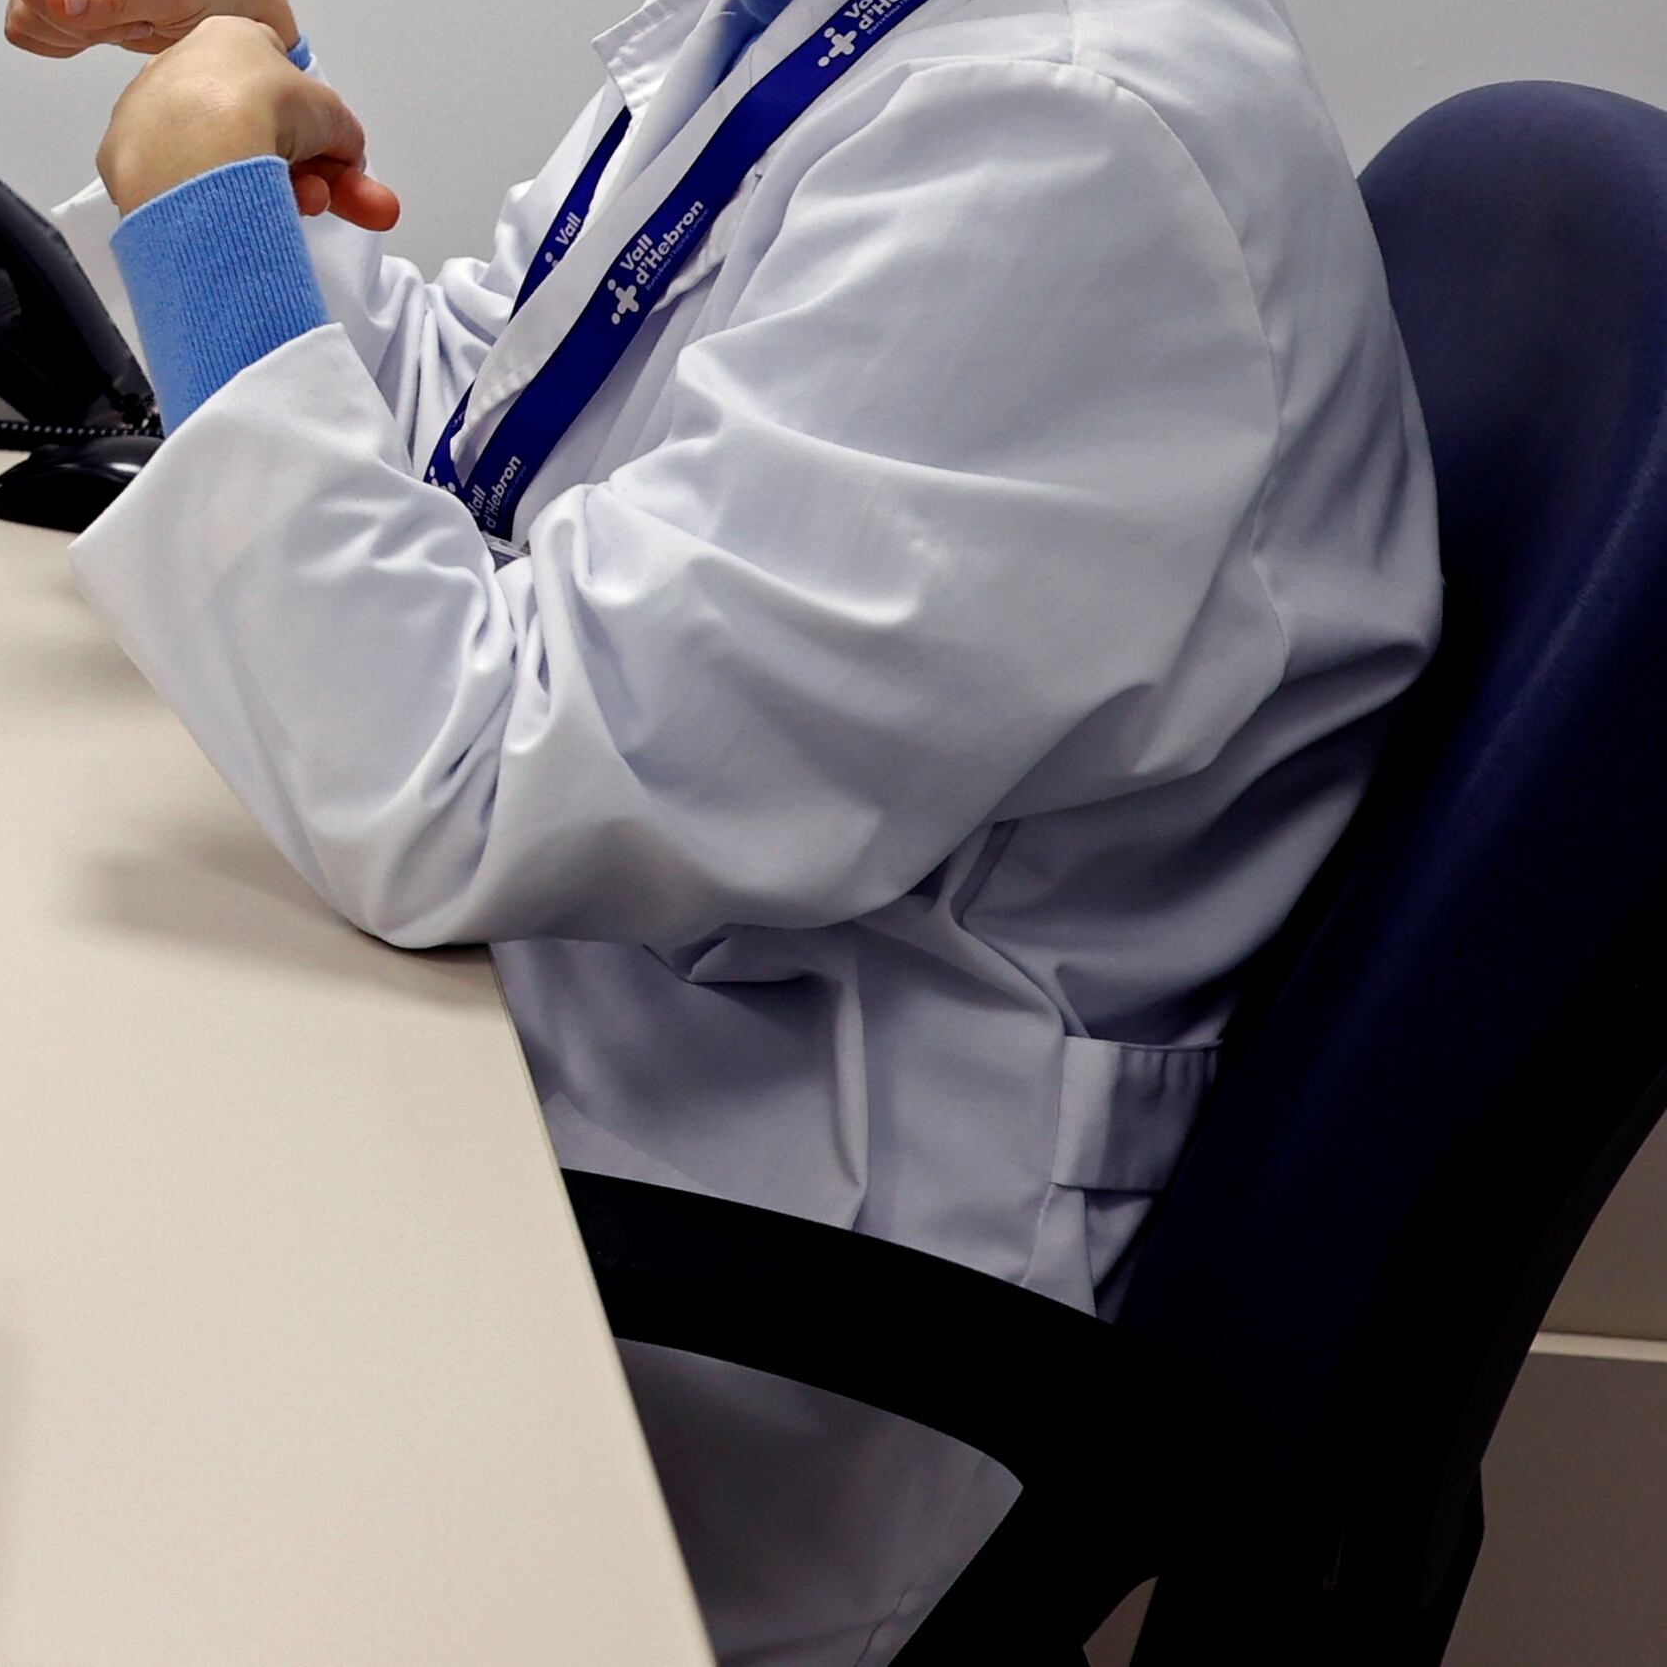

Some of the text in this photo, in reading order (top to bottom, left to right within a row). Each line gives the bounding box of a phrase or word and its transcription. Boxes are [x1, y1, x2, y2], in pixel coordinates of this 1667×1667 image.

[554, 211, 582, 245] Vall
[619, 233, 654, 271] Vall
[636, 200, 705, 285] d'Hebron
[484, 455, 522, 528] d'Hebron
